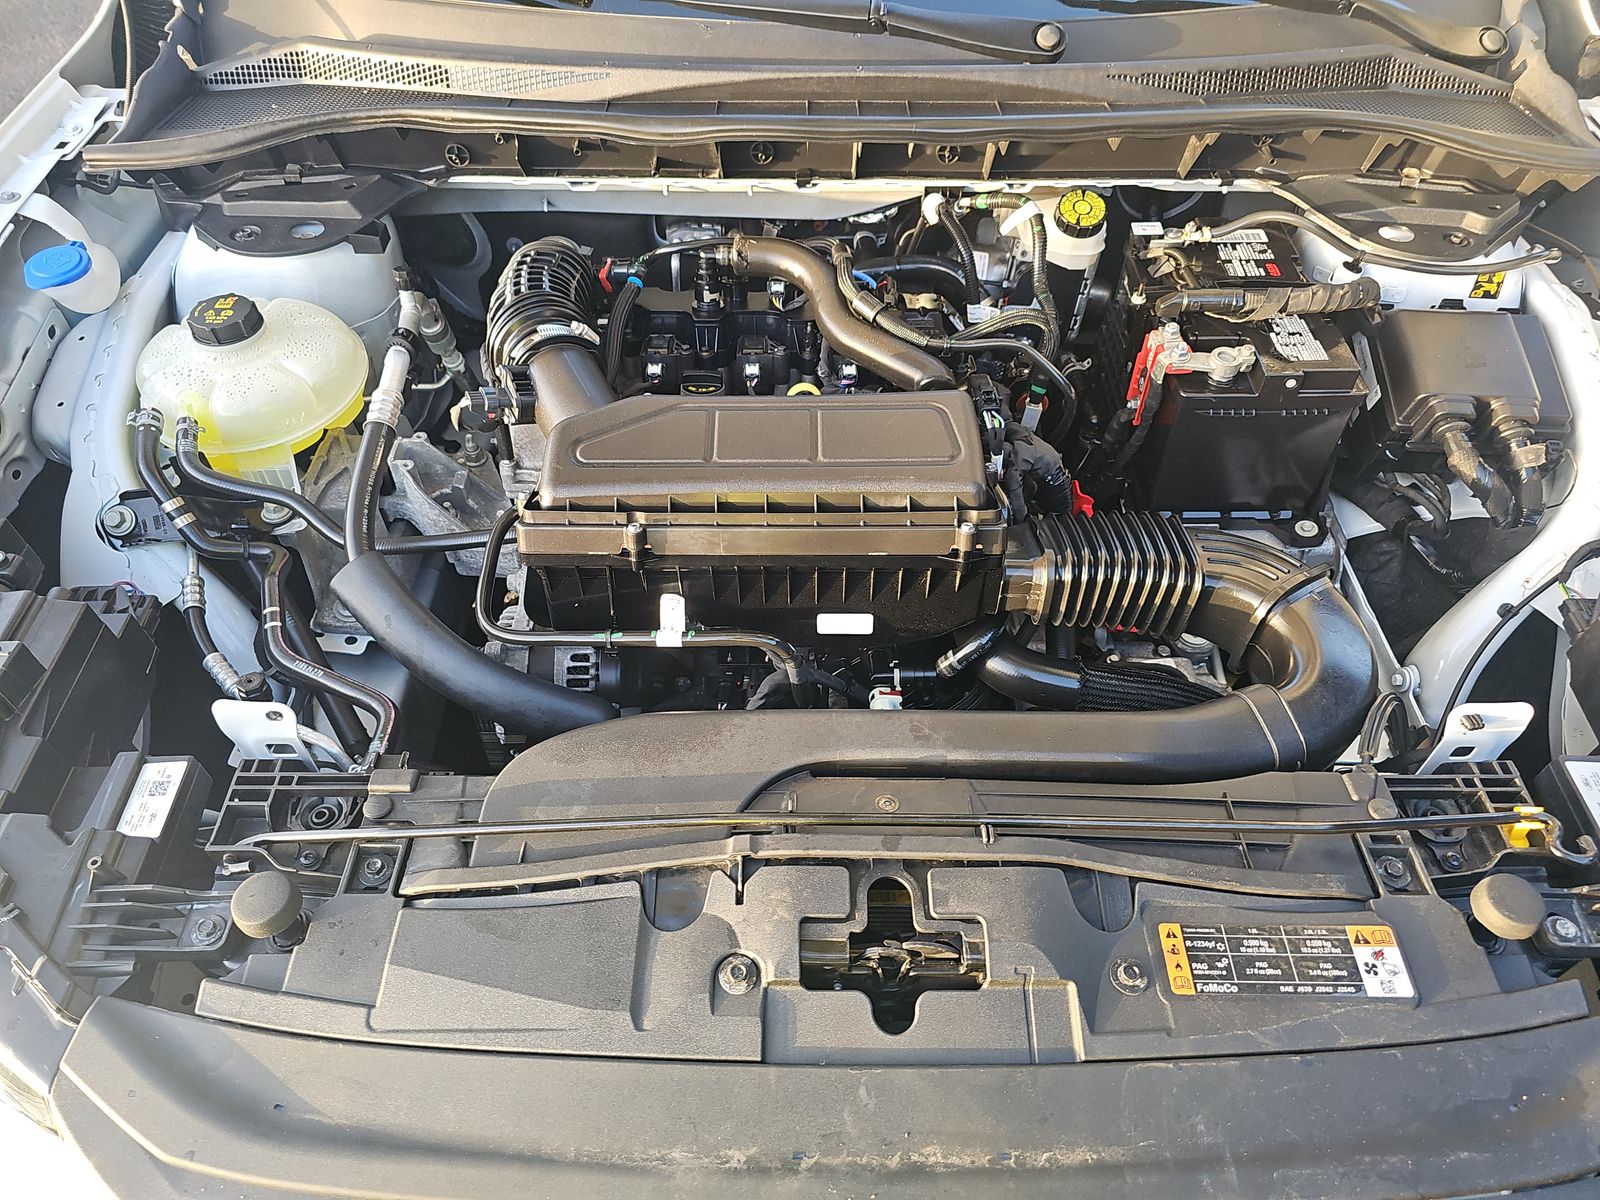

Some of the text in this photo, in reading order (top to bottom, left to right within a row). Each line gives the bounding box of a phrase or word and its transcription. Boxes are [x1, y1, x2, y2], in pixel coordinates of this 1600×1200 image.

[367, 470, 376, 486] HOSE
[1185, 940, 1216, 949] R-1234yf
[1322, 940, 1332, 948] kg
[1191, 962, 1209, 970] PAG
[1196, 983, 1239, 993] FoMoCo
